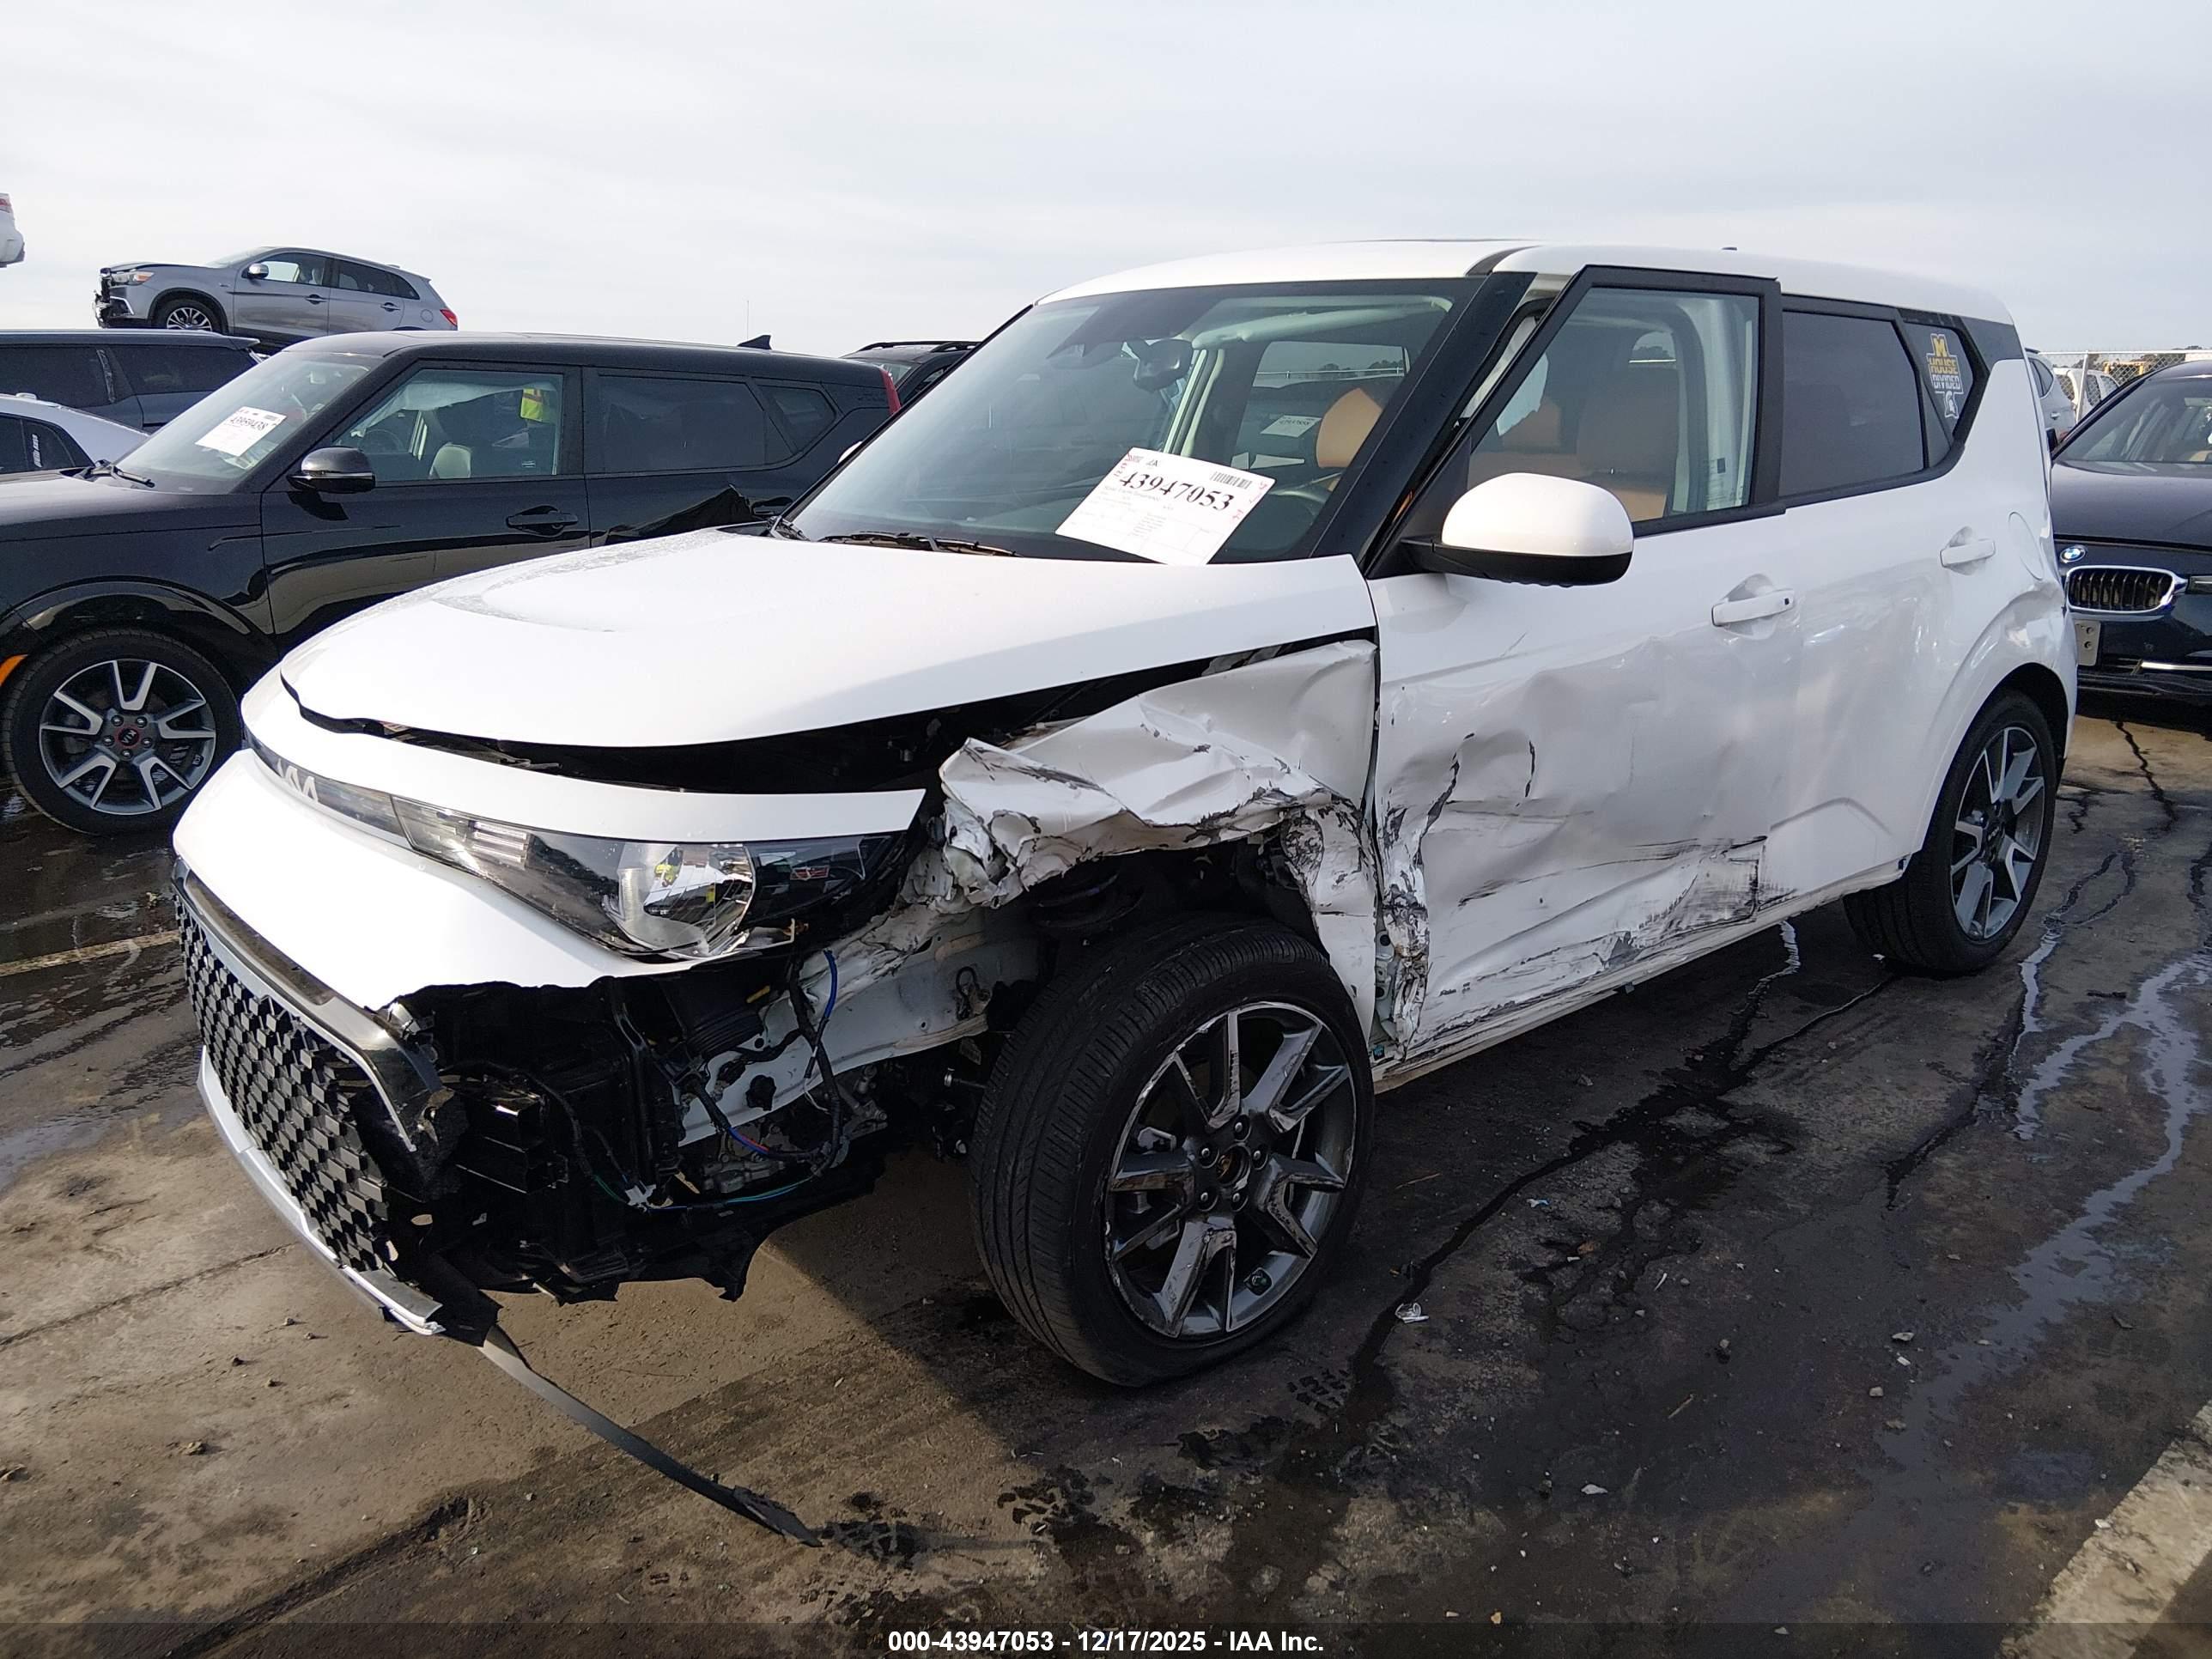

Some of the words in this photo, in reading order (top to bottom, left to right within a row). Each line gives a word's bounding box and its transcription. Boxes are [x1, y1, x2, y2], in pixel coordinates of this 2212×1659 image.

[1929, 357, 1959, 374] HOUSE
[1932, 374, 1961, 390] DIVIDED
[1120, 471, 1234, 511] 43947053
